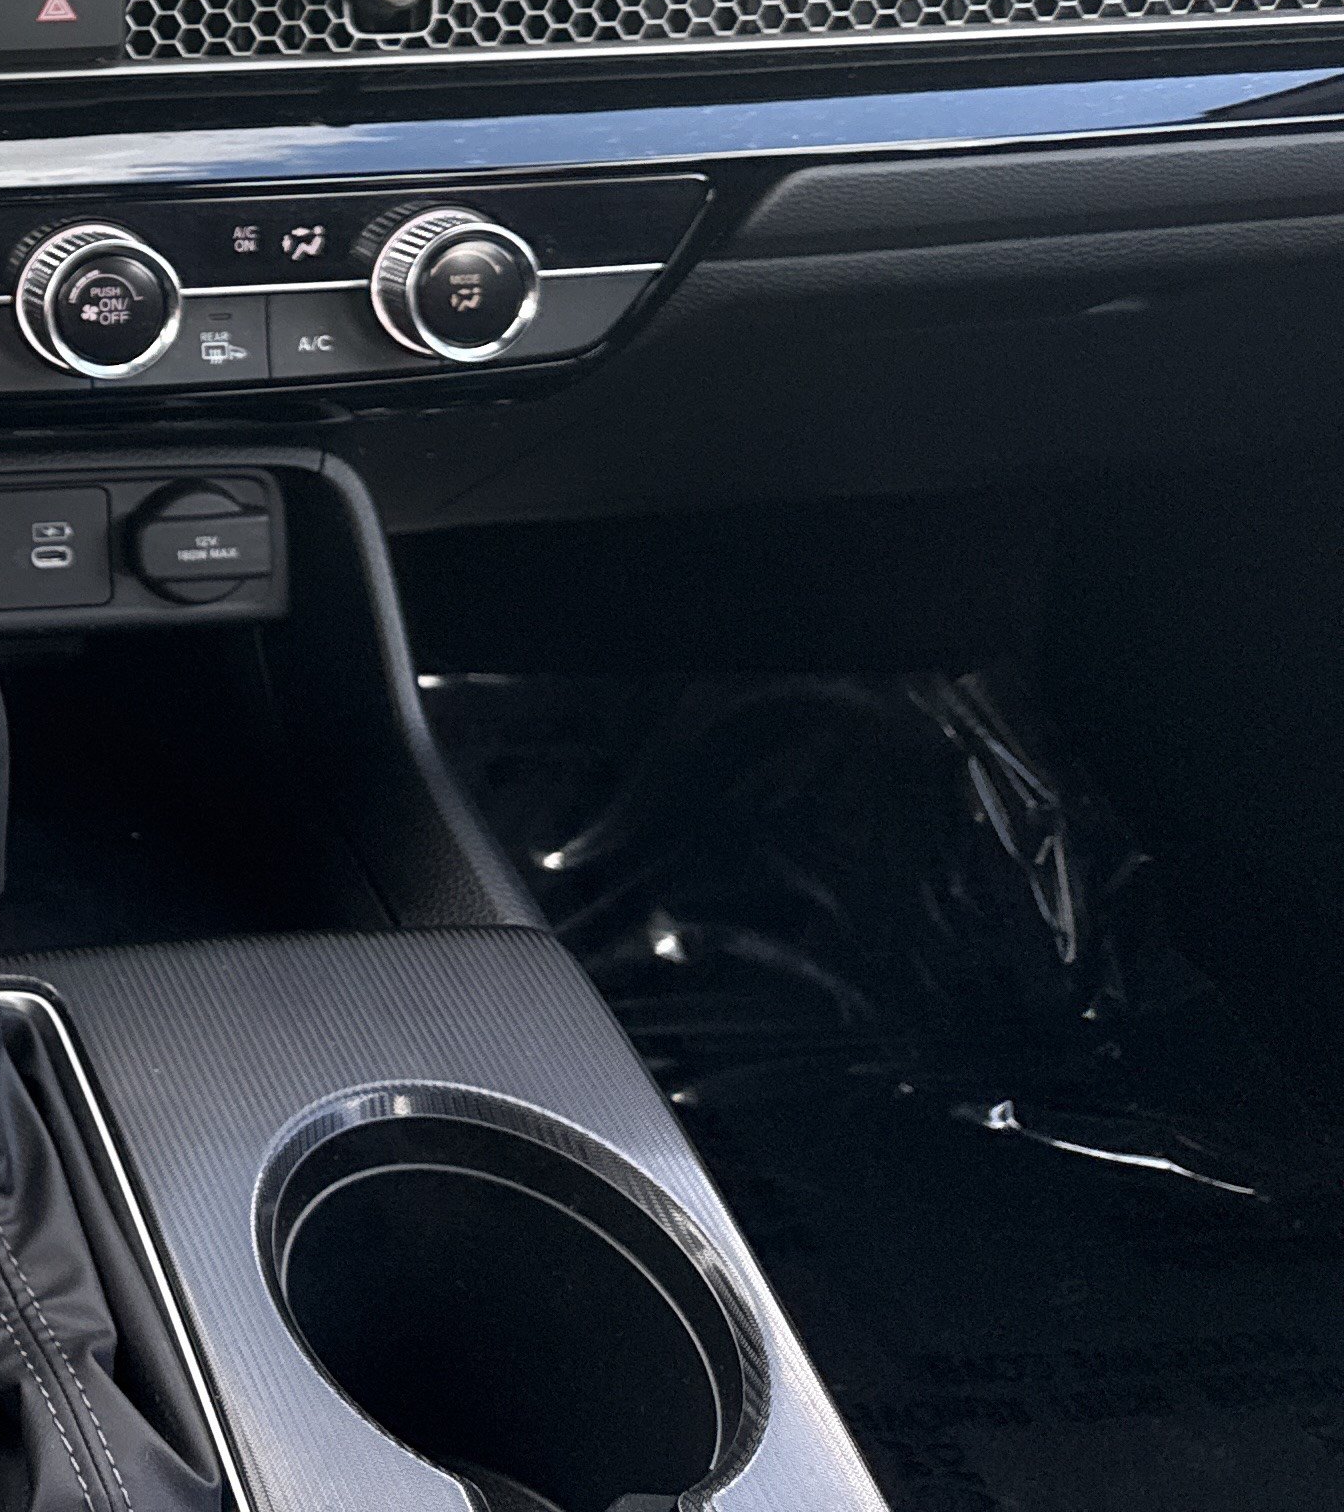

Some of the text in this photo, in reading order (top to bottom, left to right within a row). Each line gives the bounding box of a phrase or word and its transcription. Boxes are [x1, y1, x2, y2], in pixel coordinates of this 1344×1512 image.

[233, 225, 258, 239] A/C
[234, 239, 258, 253] ON
[90, 286, 121, 297] PUSH
[99, 297, 129, 312] ON/
[99, 311, 130, 326] OFF
[200, 332, 230, 342] REAR
[298, 334, 333, 352] A/C
